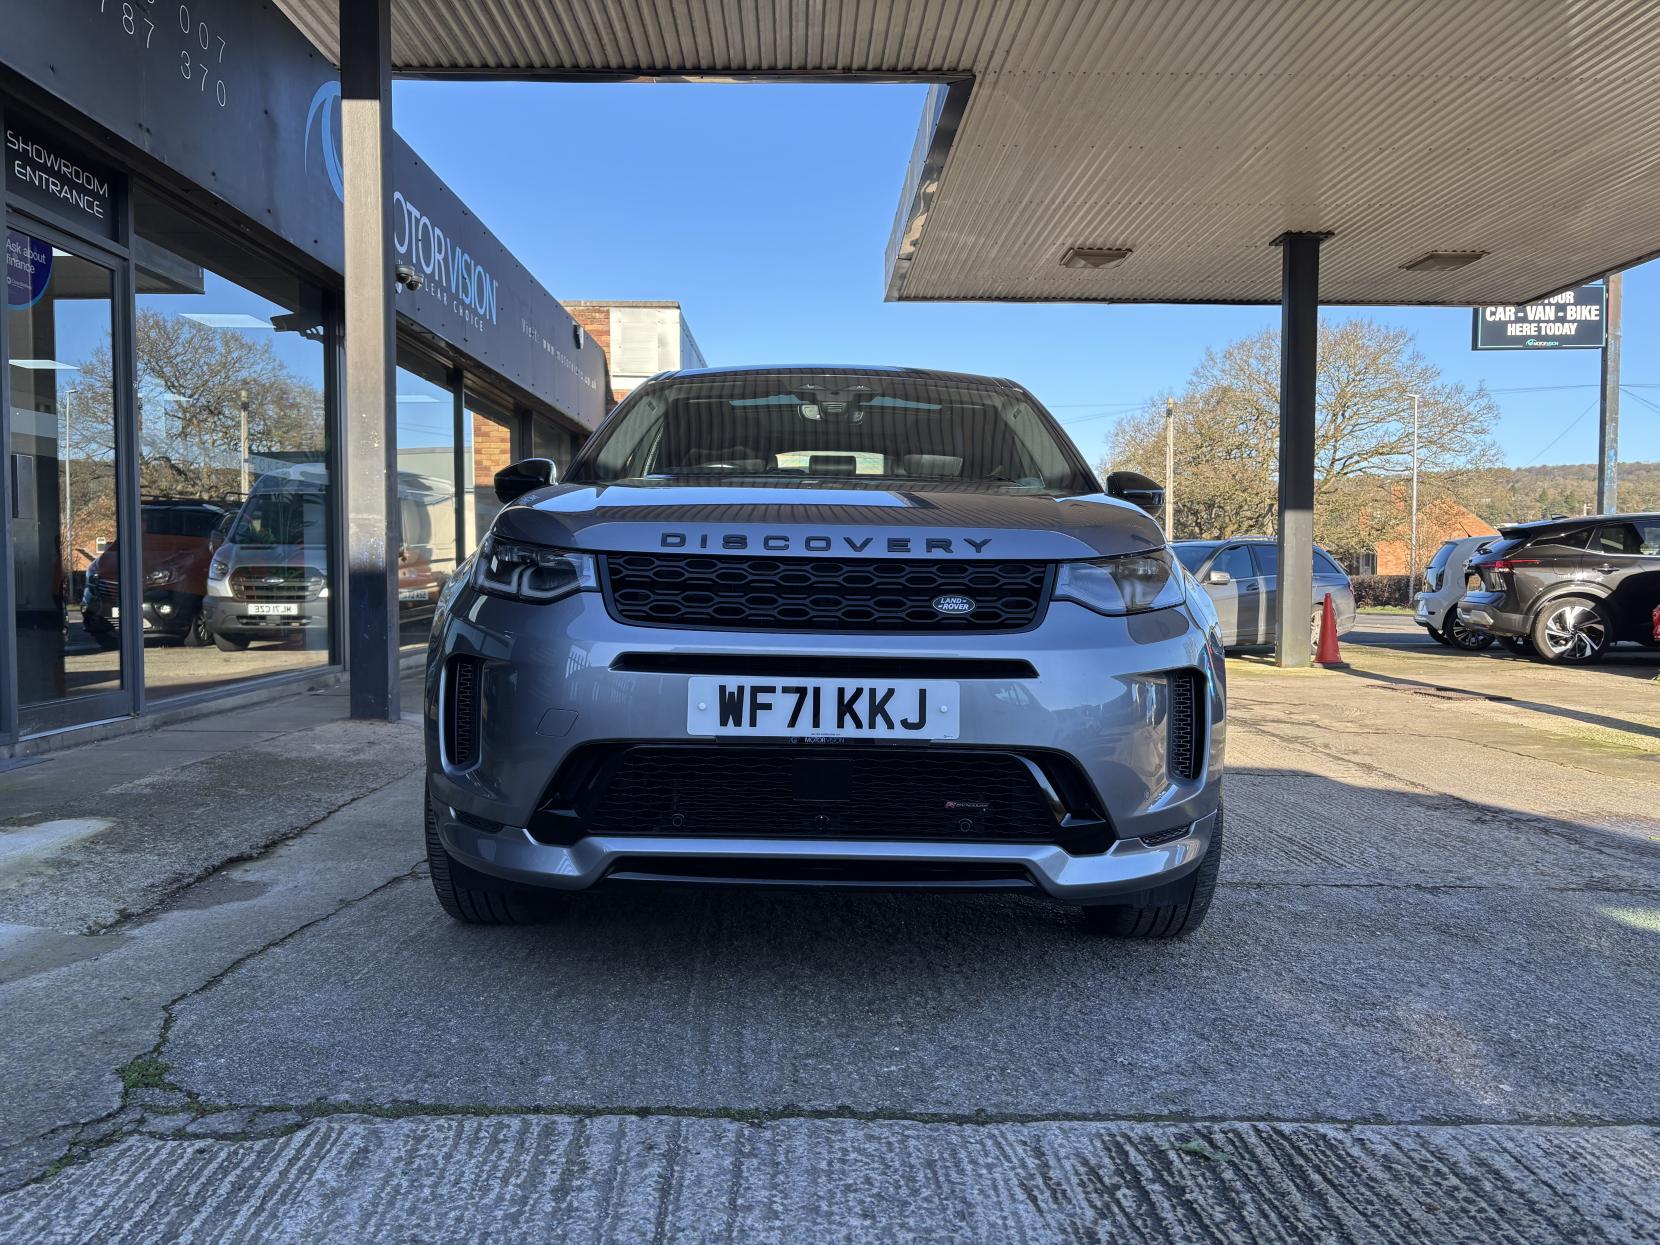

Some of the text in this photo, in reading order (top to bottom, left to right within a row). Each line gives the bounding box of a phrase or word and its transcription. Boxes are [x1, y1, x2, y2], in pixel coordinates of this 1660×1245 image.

[179, 5, 226, 63] 007
[181, 51, 226, 107] 370
[6, 130, 108, 198] SHOWROOM
[15, 160, 104, 218] ENTRANCE
[6, 238, 46, 265] Ask about
[7, 253, 35, 274] finance
[425, 278, 484, 332] LEAR CHOICE
[1485, 306, 1516, 322] CAR
[1526, 305, 1556, 321] VAN
[1566, 305, 1600, 321] BIKE
[1507, 322, 1578, 336] HERE TODAY
[660, 532, 993, 554] DISCOVERY
[718, 684, 927, 731] WF71 KKJ
